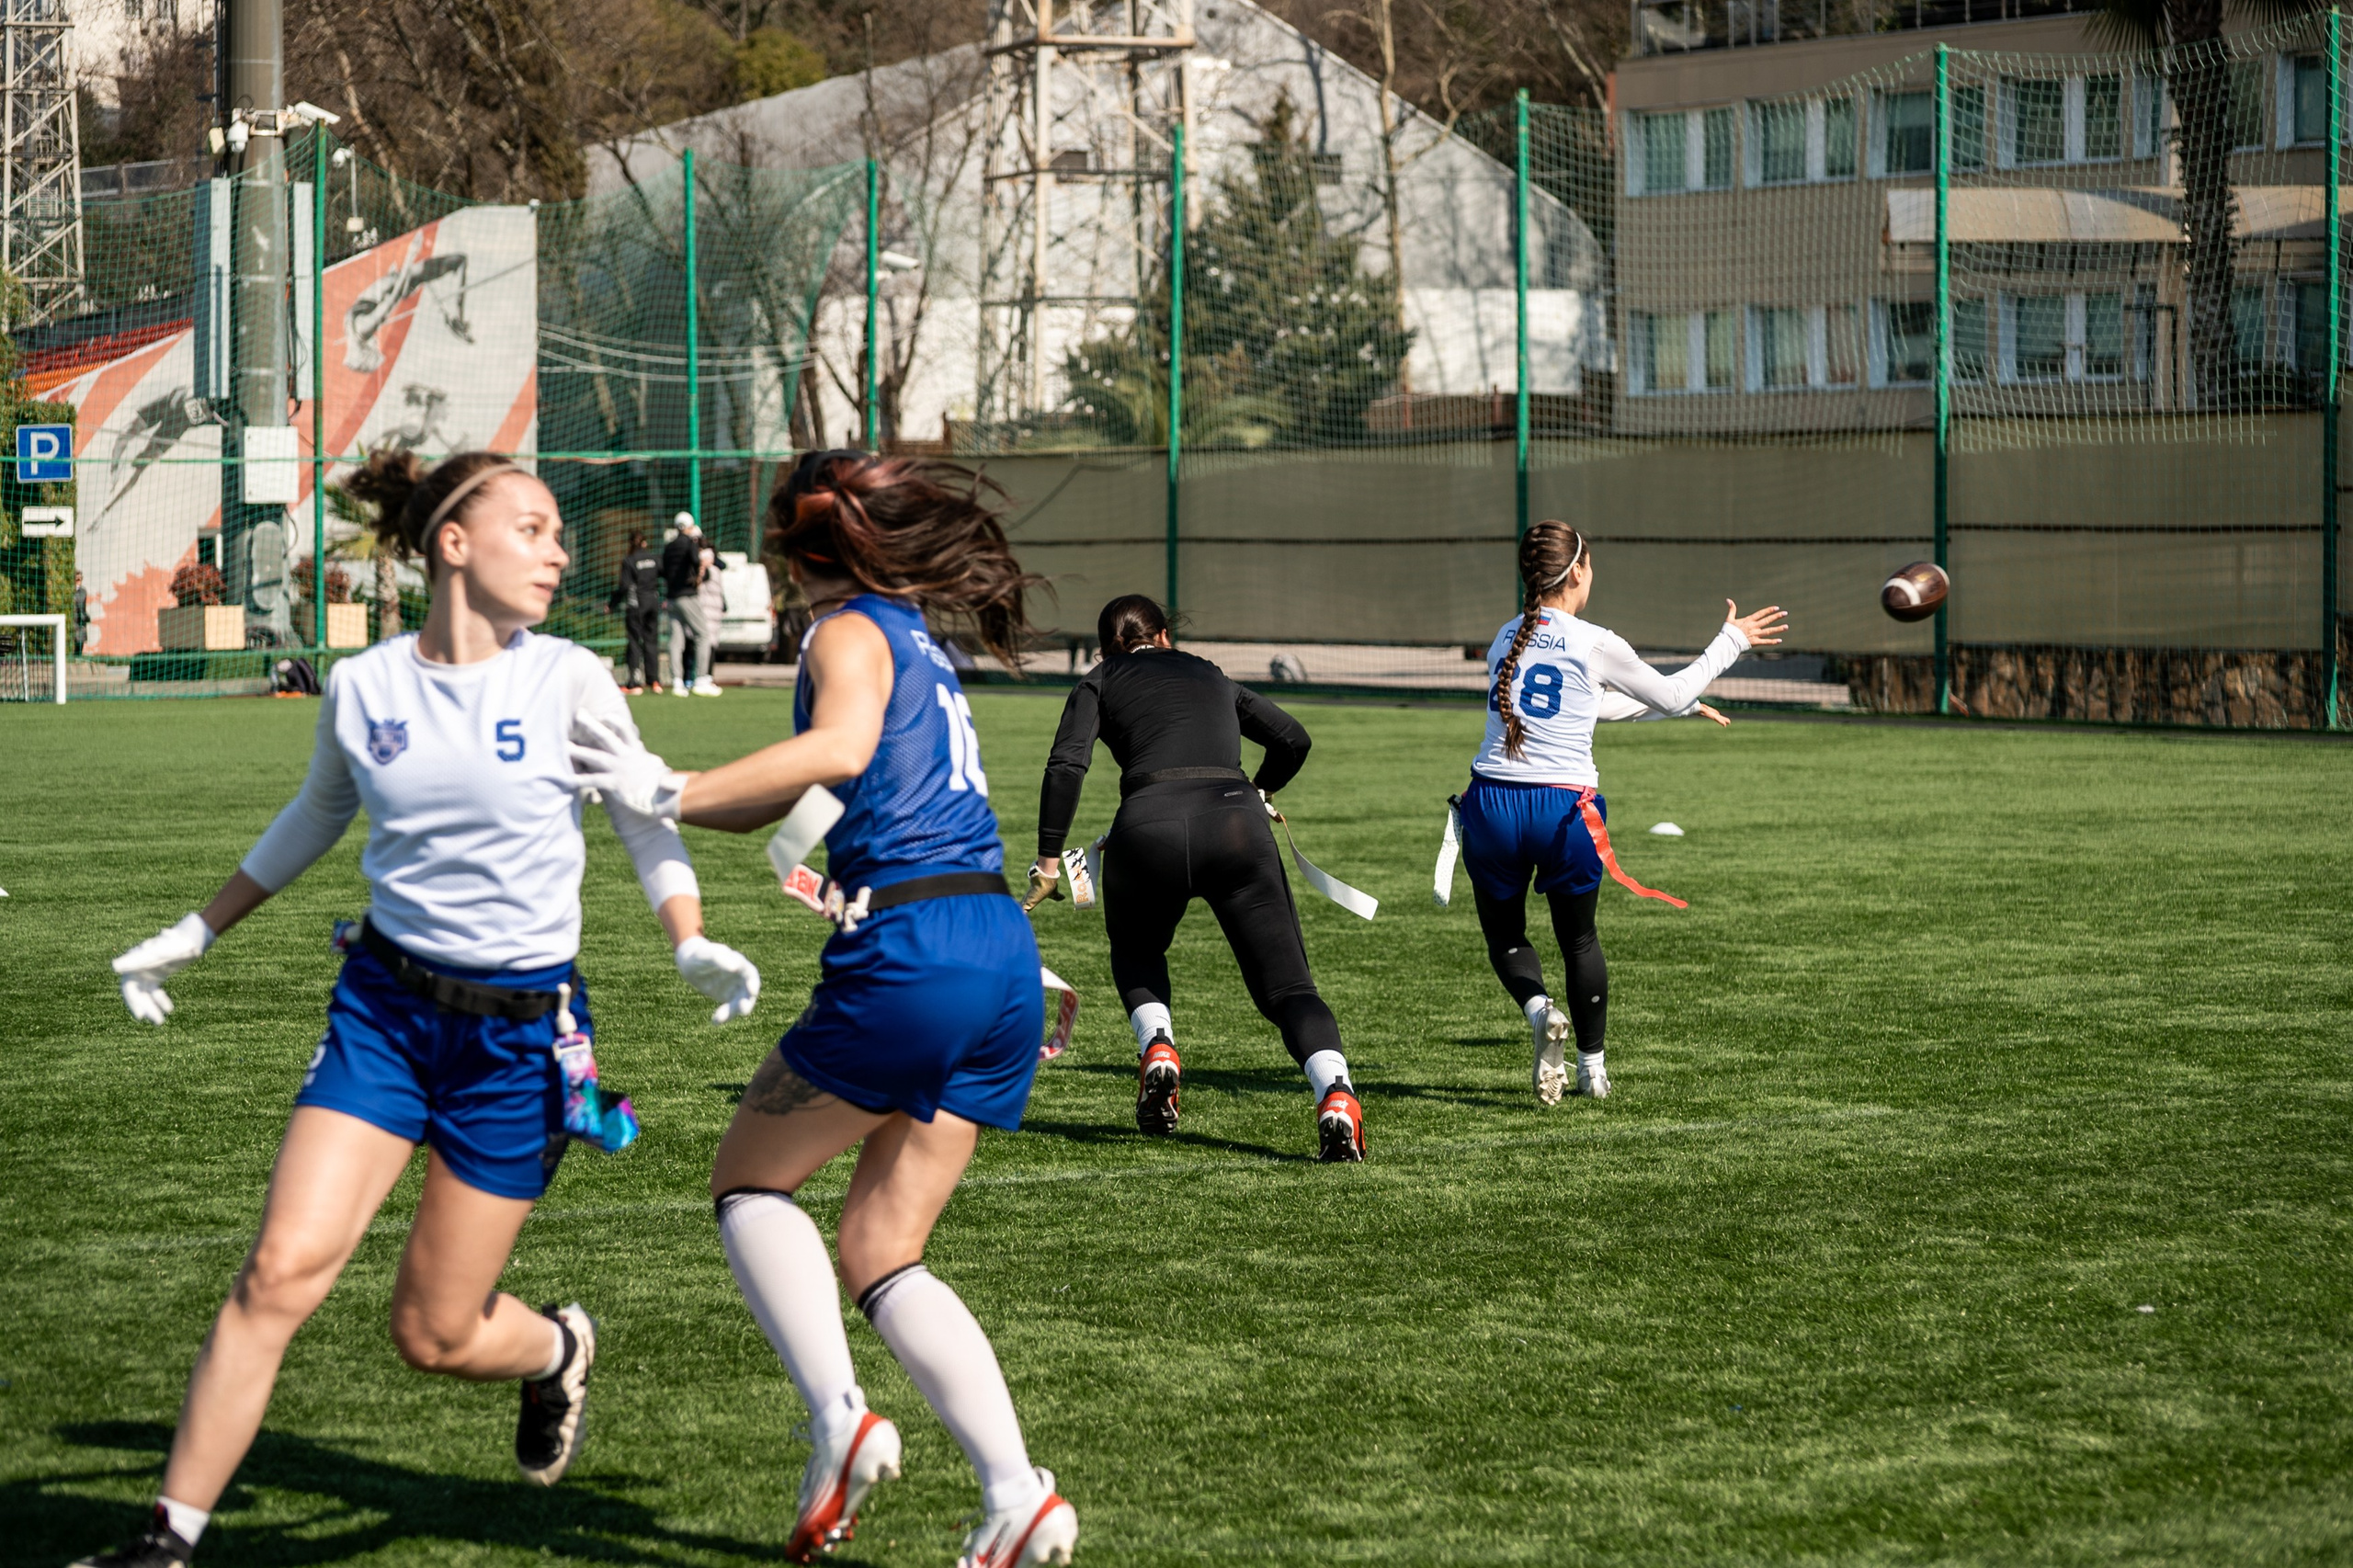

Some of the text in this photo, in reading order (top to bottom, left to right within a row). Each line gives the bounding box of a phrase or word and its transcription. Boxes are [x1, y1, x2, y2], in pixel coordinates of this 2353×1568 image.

[30, 432, 60, 475] P
[1503, 630, 1565, 652] RSSIA
[496, 720, 525, 761] 5
